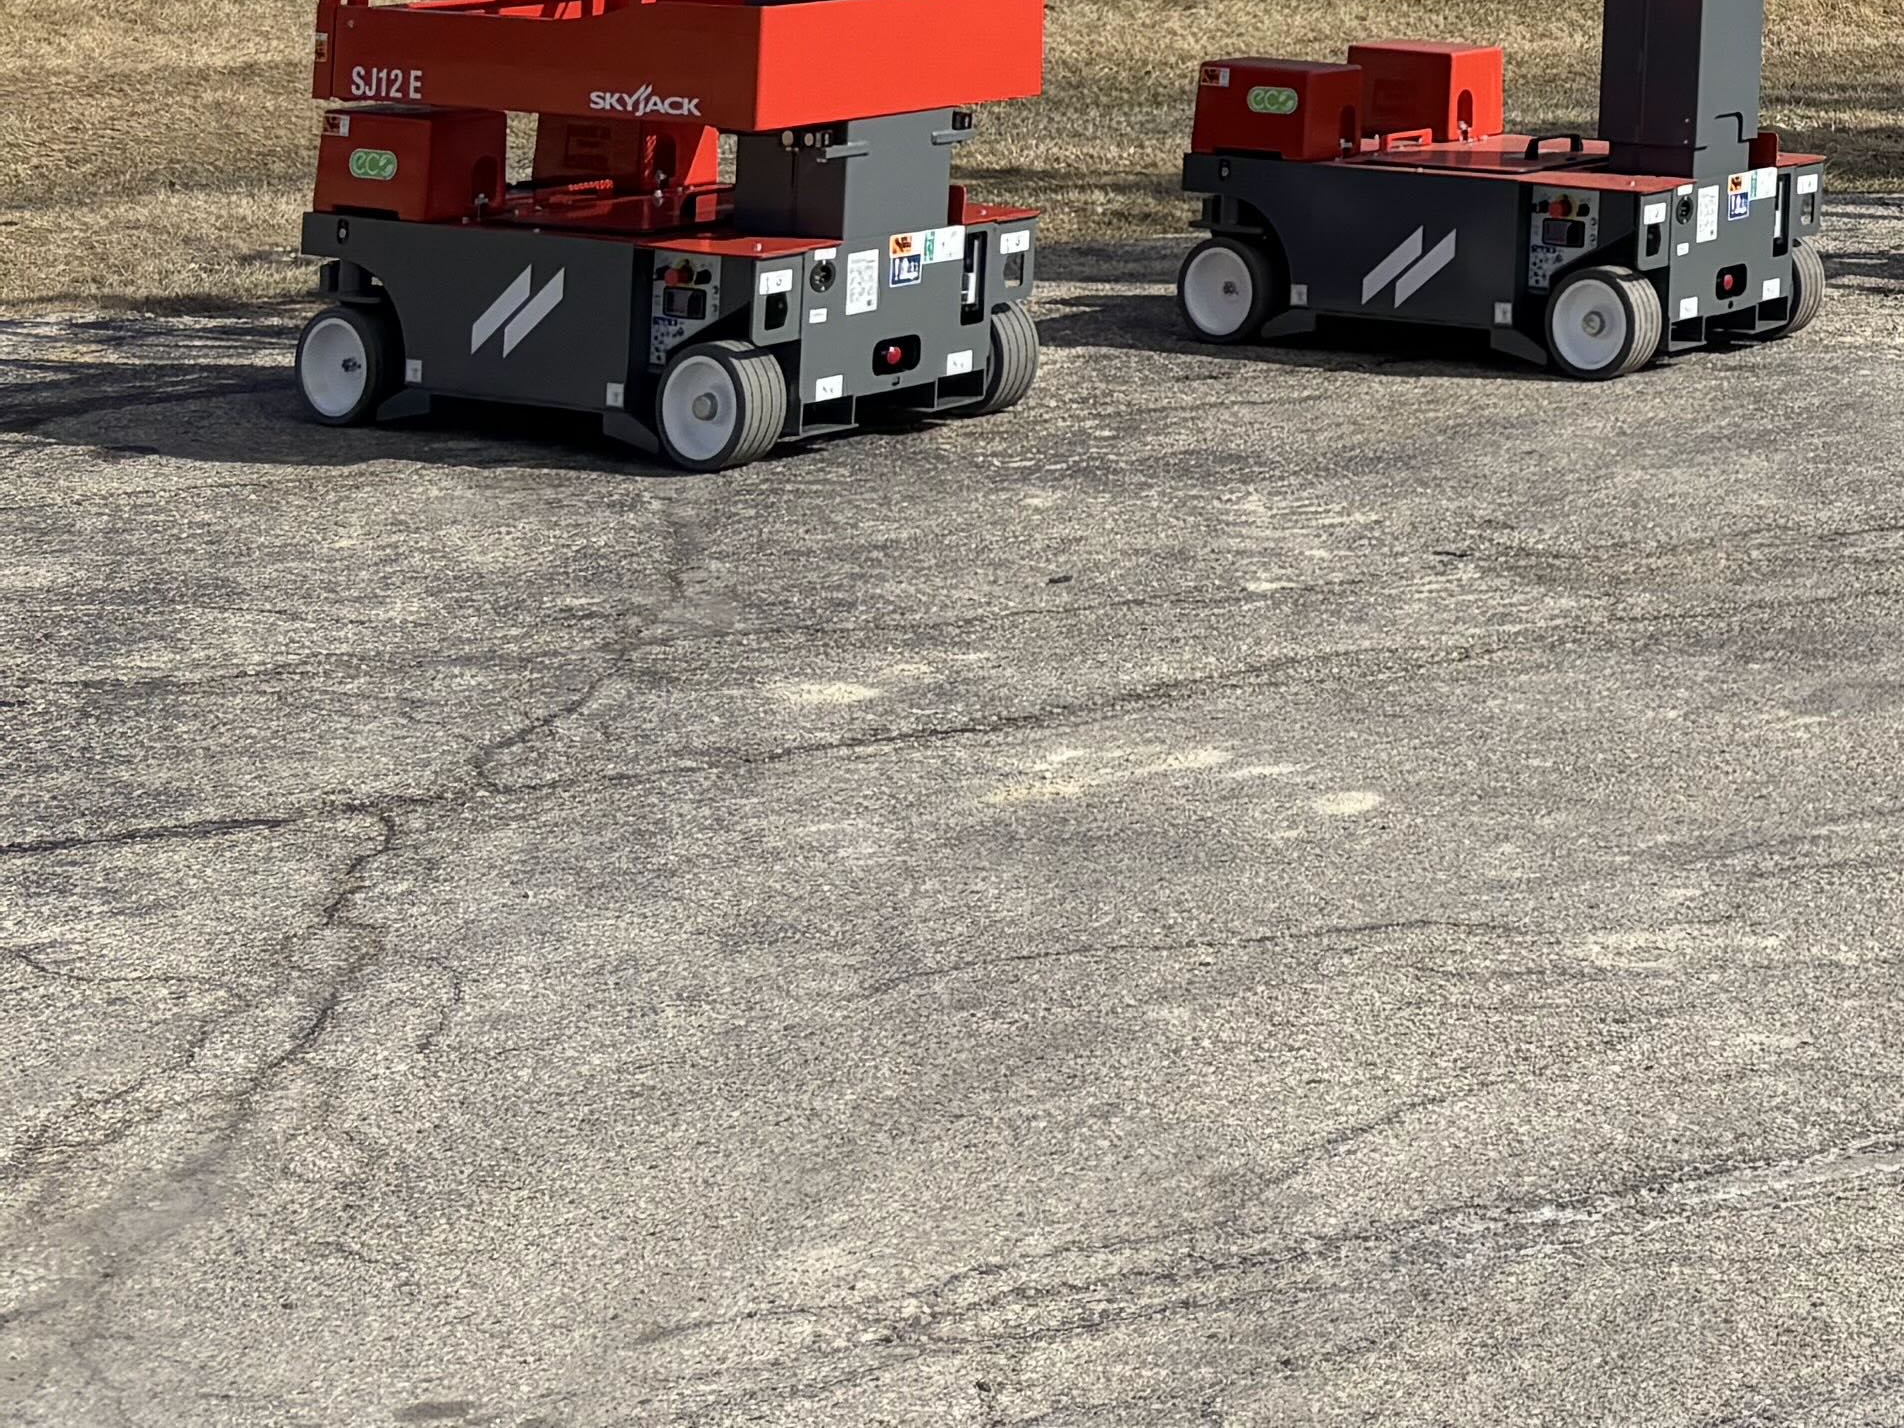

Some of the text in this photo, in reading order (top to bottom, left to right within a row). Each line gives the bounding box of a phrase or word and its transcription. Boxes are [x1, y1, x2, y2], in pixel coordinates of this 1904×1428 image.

[351, 65, 423, 99] SJ12 E
[589, 83, 700, 116] SKYJACK
